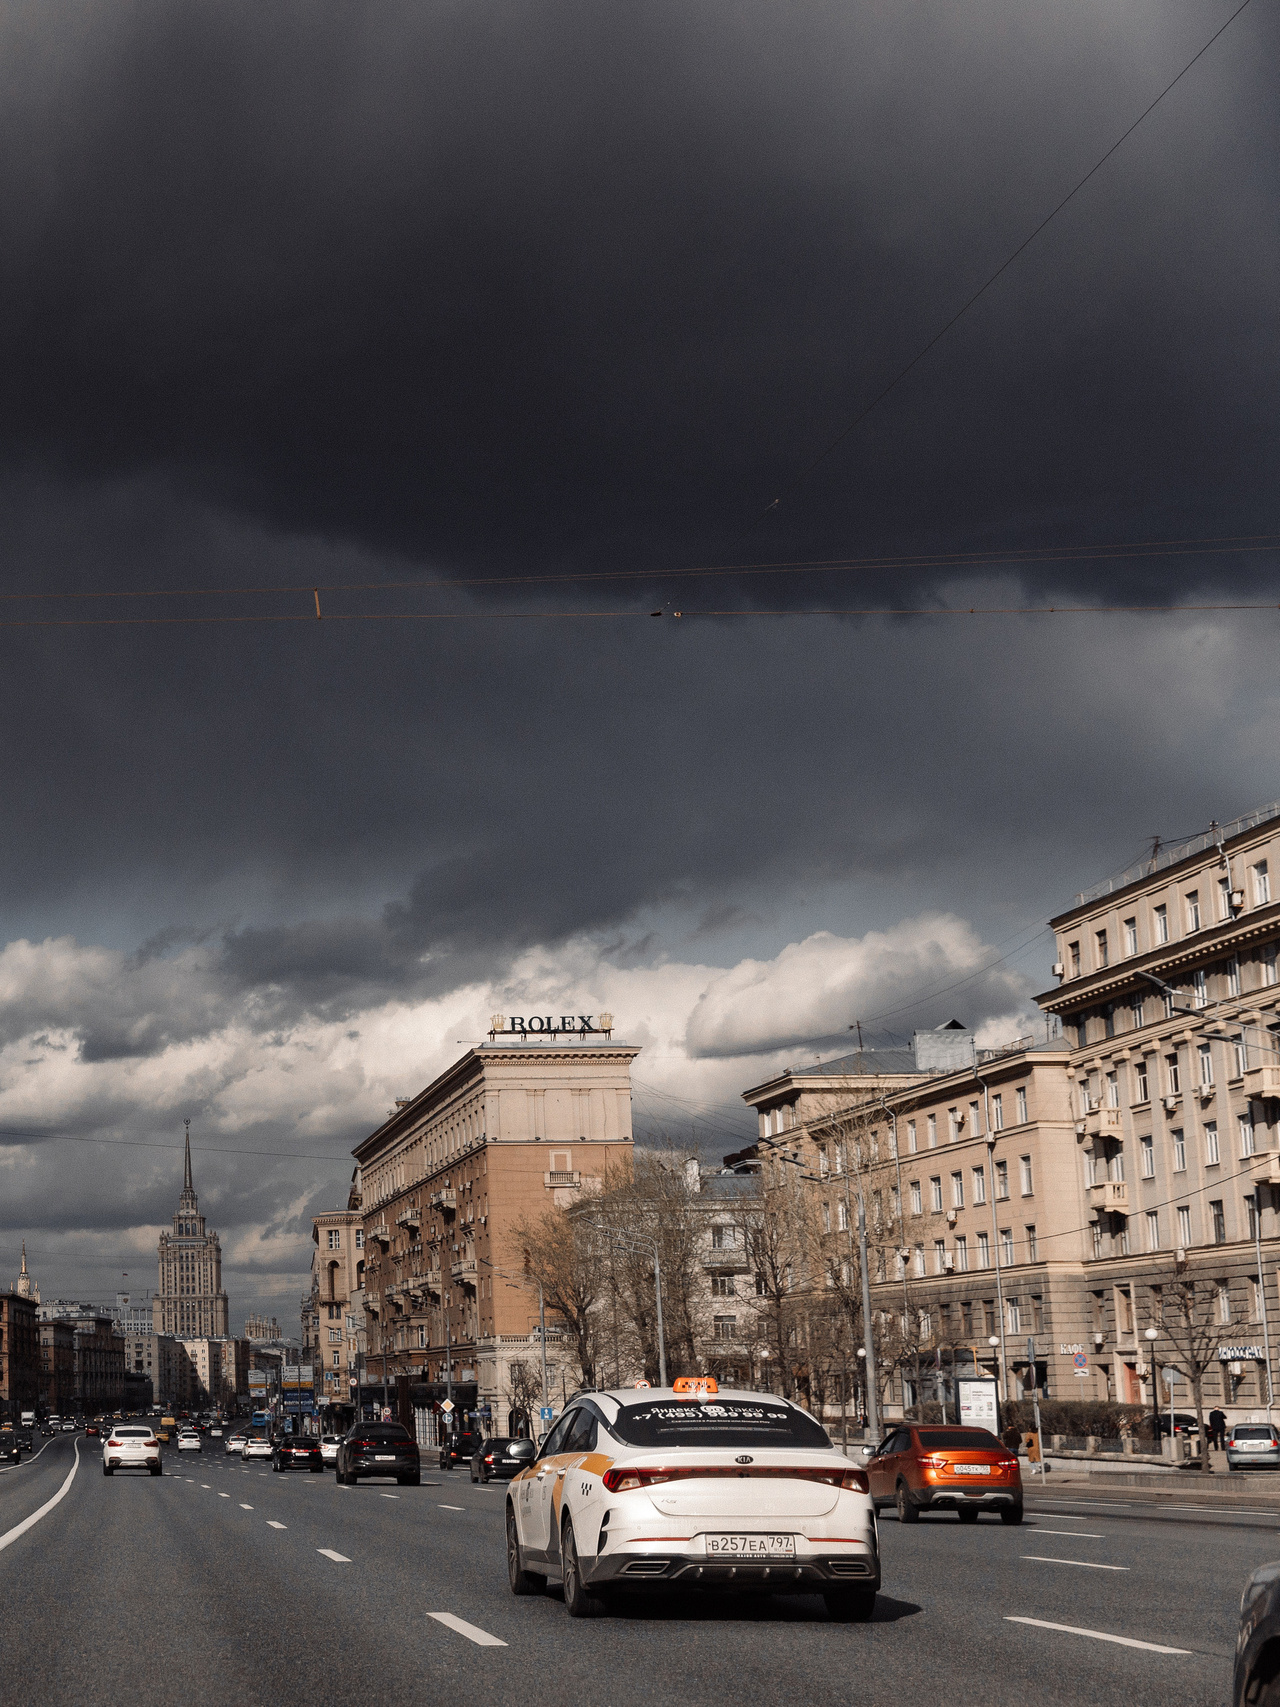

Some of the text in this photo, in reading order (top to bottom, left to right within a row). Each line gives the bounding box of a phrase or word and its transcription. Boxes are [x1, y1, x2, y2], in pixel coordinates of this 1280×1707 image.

[509, 1016, 594, 1032] ROLEX
[711, 1536, 790, 1551] В257ЕА 797
